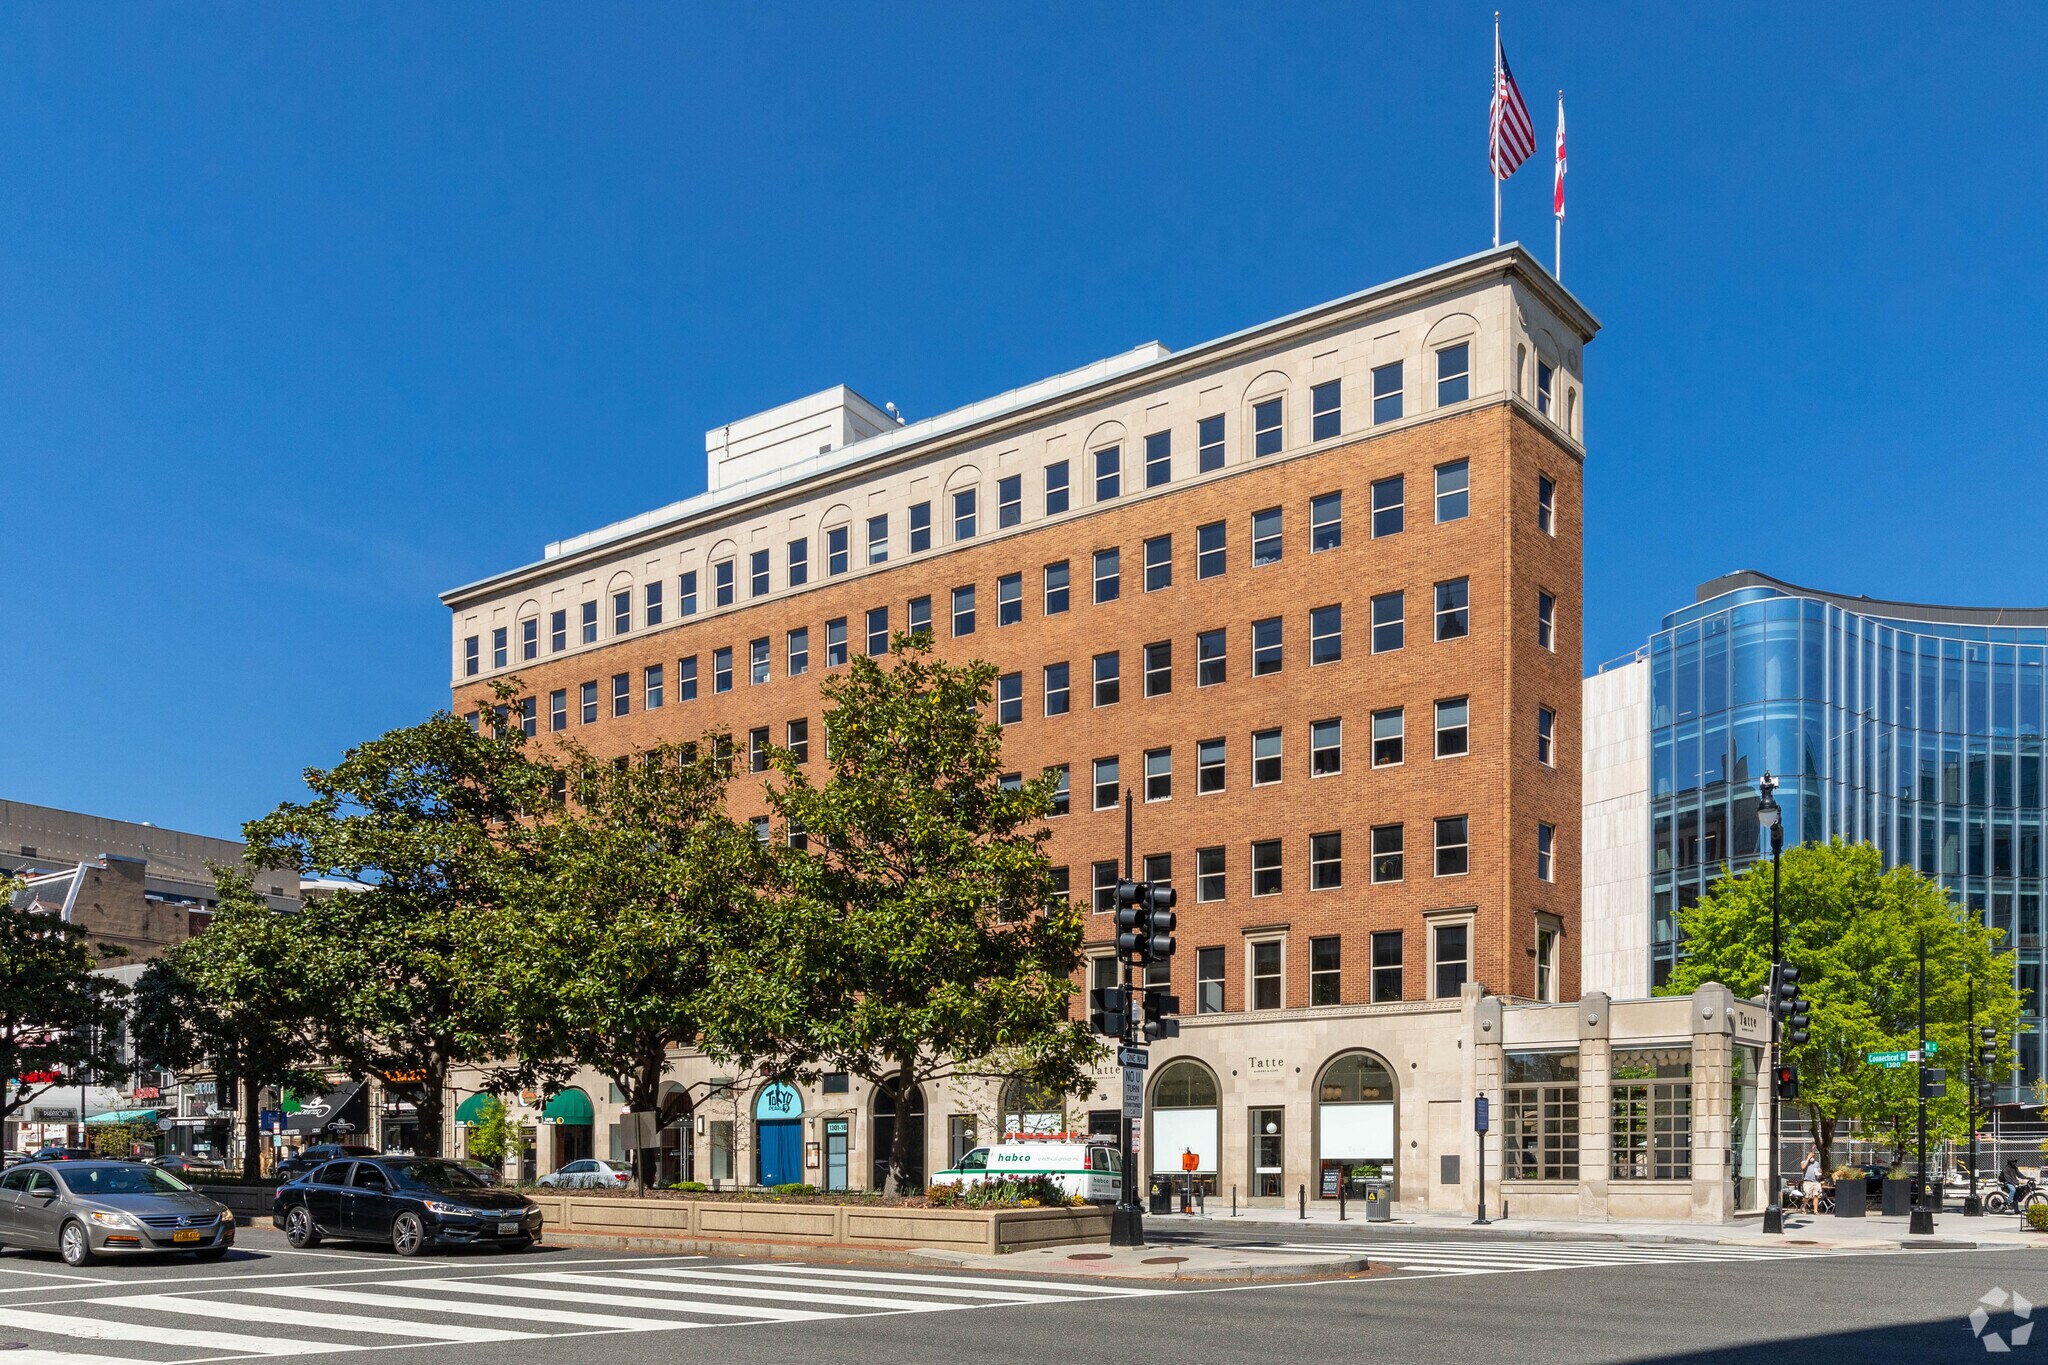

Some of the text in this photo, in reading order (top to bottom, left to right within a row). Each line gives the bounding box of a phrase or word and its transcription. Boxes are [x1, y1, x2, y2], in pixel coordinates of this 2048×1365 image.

[1739, 1011, 1757, 1028] Tatte
[1925, 1042, 1930, 1051] N
[1126, 1053, 1146, 1065] ONE WAY
[1248, 1056, 1284, 1068] Tatte
[1868, 1053, 1899, 1063] Connecticut
[1125, 1070, 1141, 1083] NO U
[1126, 1084, 1140, 1093] TURN
[997, 1153, 1031, 1162] habco
